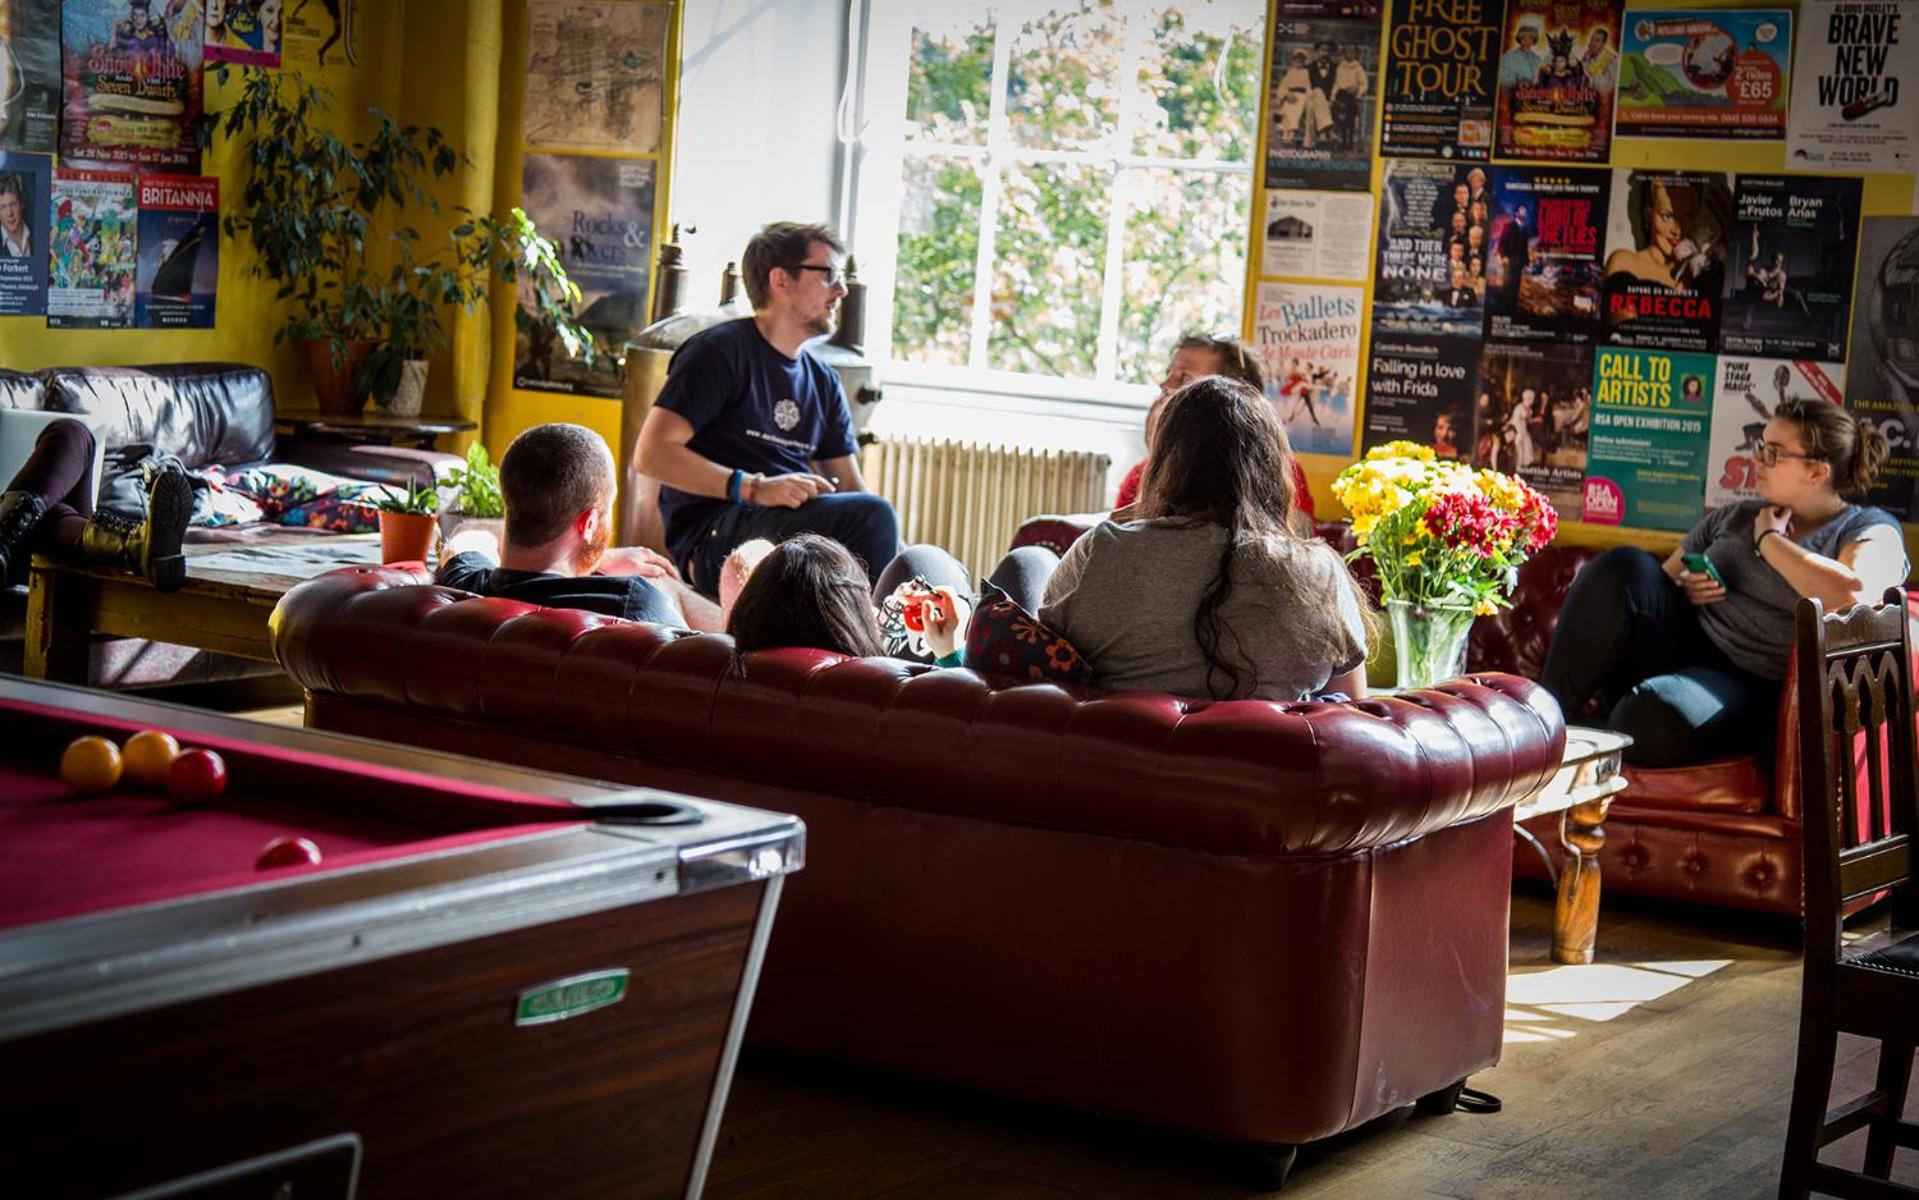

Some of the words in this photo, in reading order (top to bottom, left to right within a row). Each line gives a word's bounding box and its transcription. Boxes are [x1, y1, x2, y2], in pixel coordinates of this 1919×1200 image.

[1828, 14, 1900, 44] BRAVE
[1392, 23, 1499, 61] GHOST
[1835, 45, 1888, 75] NEW
[96, 75, 131, 94] Seven
[1396, 61, 1488, 97] TOUR
[1740, 80, 1773, 100] £65
[1818, 76, 1899, 107] WORLD
[142, 187, 214, 208] BRITANNIA
[1739, 193, 1774, 206] Javier
[1789, 194, 1823, 208] Bryan
[1747, 205, 1783, 218] Frutos
[1787, 207, 1817, 219] Arias
[624, 221, 646, 249] &
[1389, 238, 1413, 252] AND
[1415, 240, 1443, 253] THEN
[1538, 225, 1559, 244] THE
[1563, 226, 1598, 246] FLIES
[1383, 252, 1416, 266] THERE
[1418, 254, 1449, 267] WERE
[1382, 266, 1448, 283] NONE
[1282, 294, 1357, 327] Ballets
[1610, 293, 1712, 320] REBECCA
[1257, 319, 1358, 345] Trockadero
[1372, 357, 1418, 380] Falling
[1420, 361, 1433, 377] in
[1435, 362, 1466, 380] love
[1599, 352, 1643, 380] CALL
[1648, 355, 1672, 383] TO
[1724, 371, 1751, 382] STAGE
[1371, 377, 1401, 394] with
[1403, 379, 1438, 398] Frida
[1597, 378, 1672, 408] ARTISTS
[1594, 413, 1611, 426] RSA
[1613, 414, 1635, 428] OPEN
[1635, 416, 1681, 431] EXHIBITION
[1682, 419, 1702, 433] 2015
[1552, 467, 1583, 479] Artists
